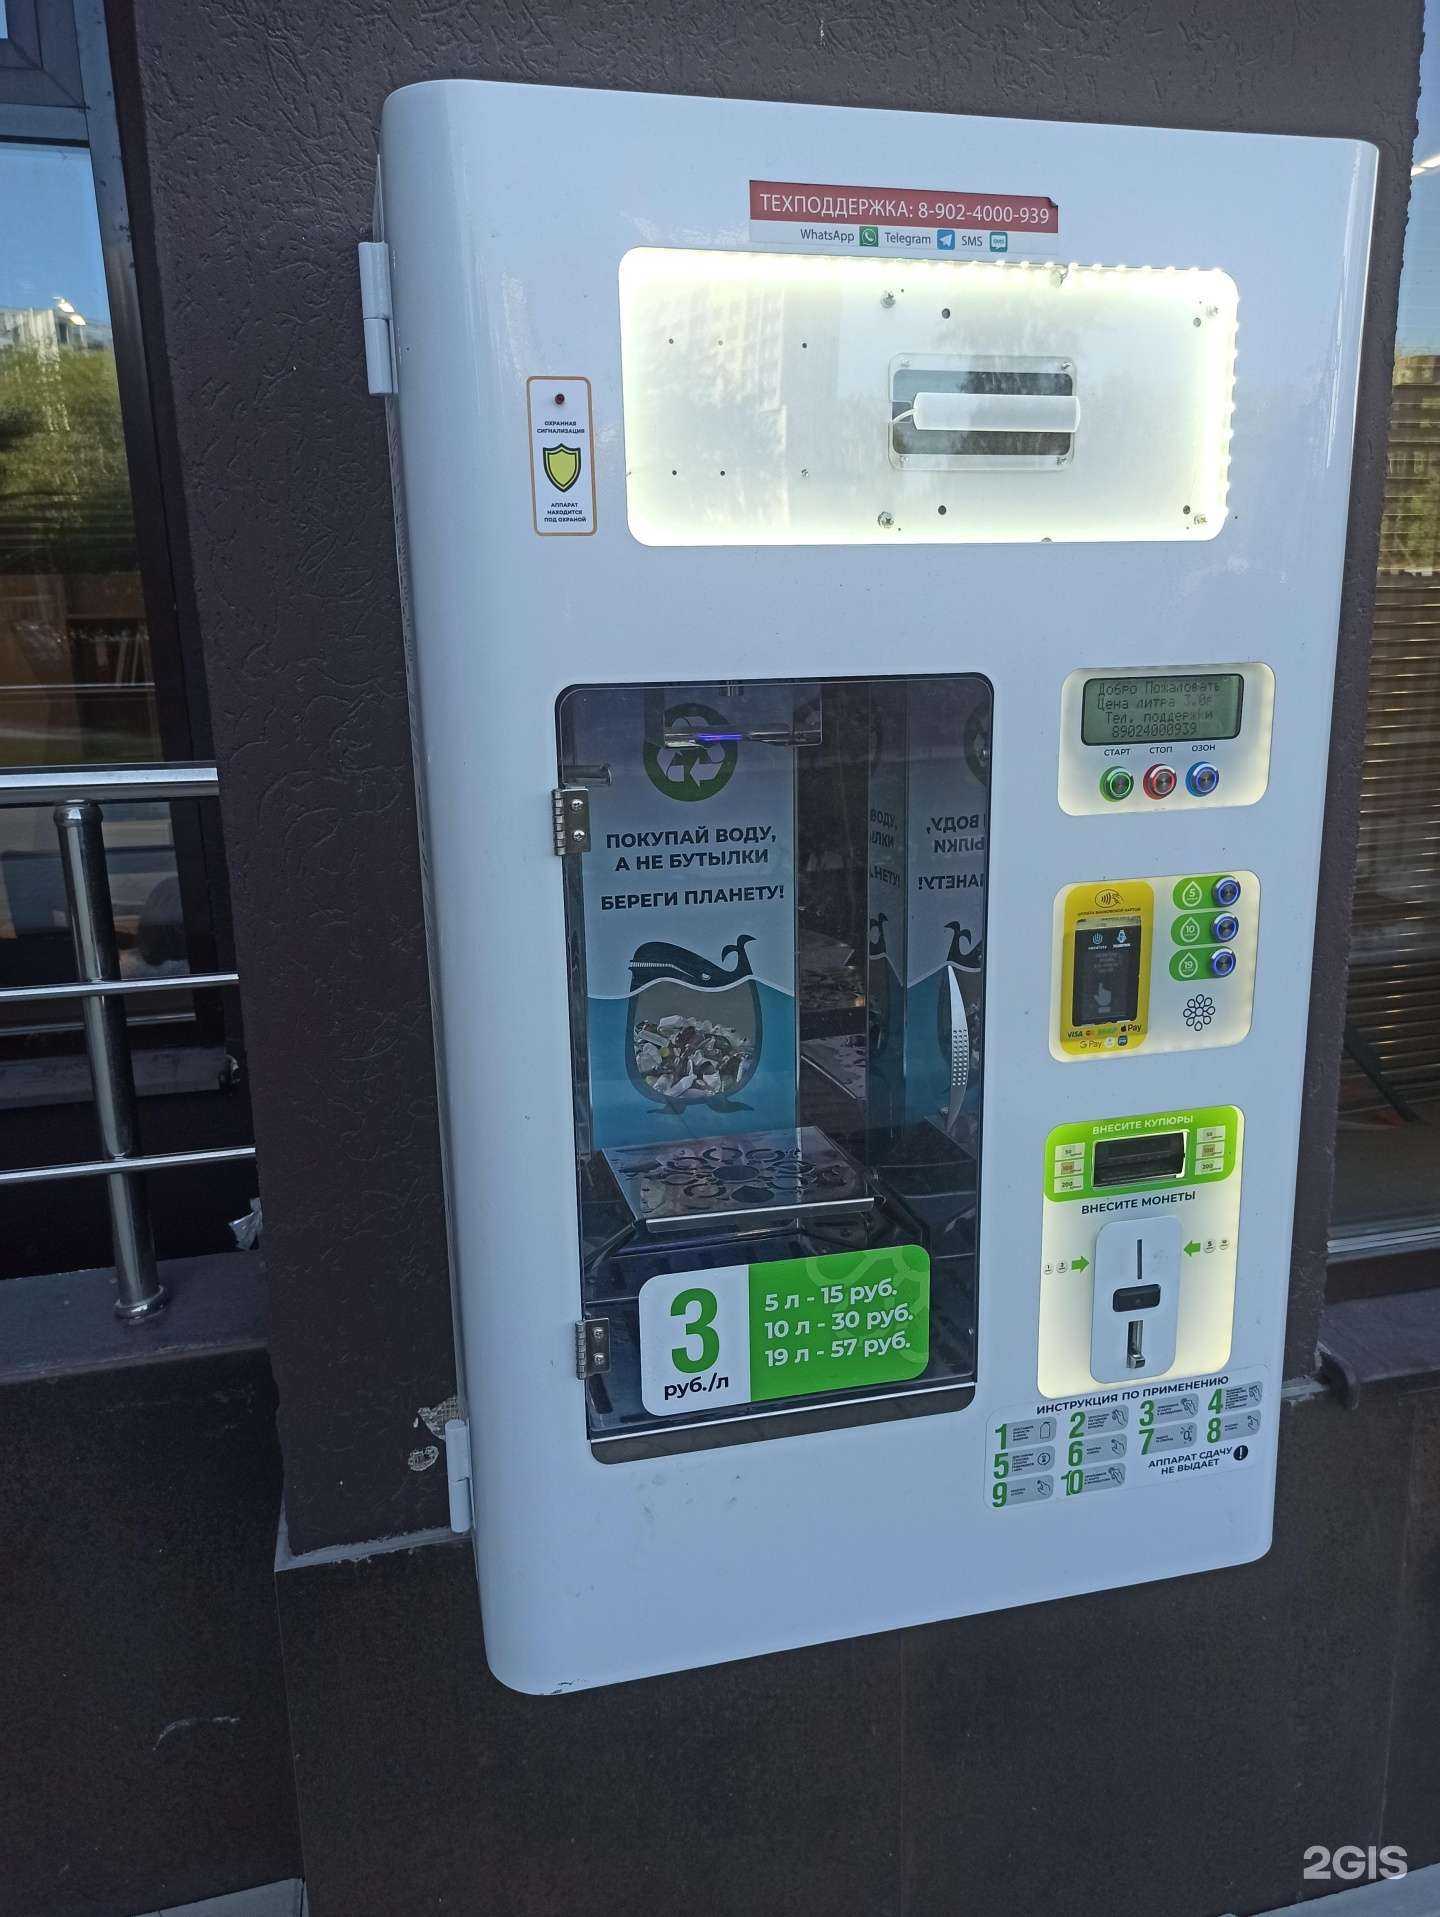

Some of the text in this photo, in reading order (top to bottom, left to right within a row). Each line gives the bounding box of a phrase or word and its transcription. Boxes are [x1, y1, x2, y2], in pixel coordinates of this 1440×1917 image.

[759, 193, 1049, 224] ТЕХПОДДЕРЖКА: 8-902-4000-939
[800, 228, 855, 243] WhatsApp
[884, 232, 932, 247] Telegram
[961, 235, 983, 247] SMS
[1097, 699, 1129, 711] Цена
[1111, 722, 1198, 738] 89024000939
[1104, 748, 1131, 756] СТАРТ
[1149, 746, 1173, 754] СТОП
[1191, 744, 1216, 752] ОЗОН
[606, 825, 777, 849] ПОКУПАЙ ВОДУ,
[615, 849, 769, 871] А НЕ БУТЫЛКИ
[601, 885, 785, 911] БЕРЕГИ ПЛАНЕТУ!
[1189, 888, 1196, 897] 5
[1185, 925, 1195, 933] 10
[1183, 961, 1193, 969] 19
[1067, 1030, 1083, 1038] VISA
[1127, 1024, 1142, 1032] Pay
[1092, 1115, 1193, 1135] ВНЕСИТЕ КУПЮРЫ
[1081, 1190, 1196, 1215] ВНЕСИТЕ МОНЕТЫ
[764, 1293, 779, 1312] 5
[784, 1294, 800, 1310] л
[820, 1285, 844, 1304] 15
[850, 1278, 898, 1305] руб.
[670, 1287, 720, 1374] 3
[764, 1320, 789, 1339] 10
[795, 1320, 810, 1335] л
[831, 1312, 860, 1330] 30
[866, 1303, 914, 1330] руб.
[764, 1348, 789, 1367] 19
[794, 1348, 809, 1363] л
[831, 1338, 858, 1358] 57
[864, 1331, 911, 1357] руб.
[664, 1372, 729, 1401] руб./л
[1036, 1392, 1118, 1415] ИНСТРУКЦИЯ
[1121, 1389, 1140, 1402] ПО
[1142, 1375, 1229, 1399] ПРИМЕНЕНИЮ
[1139, 1400, 1155, 1426] 3
[1208, 1388, 1223, 1415] 4
[995, 1423, 1007, 1450] 1
[1069, 1411, 1086, 1439] 2
[1207, 1417, 1221, 1443] 8
[1068, 1440, 1083, 1467] 6
[1138, 1428, 1154, 1455] 7
[993, 1452, 1009, 1479] 5
[1148, 1446, 1233, 1468] АППАРАТ СДАЧУ
[1161, 1458, 1220, 1475] НЕ ВЫДАЕТ
[992, 1482, 1007, 1508] 9
[1061, 1469, 1084, 1496] 10
